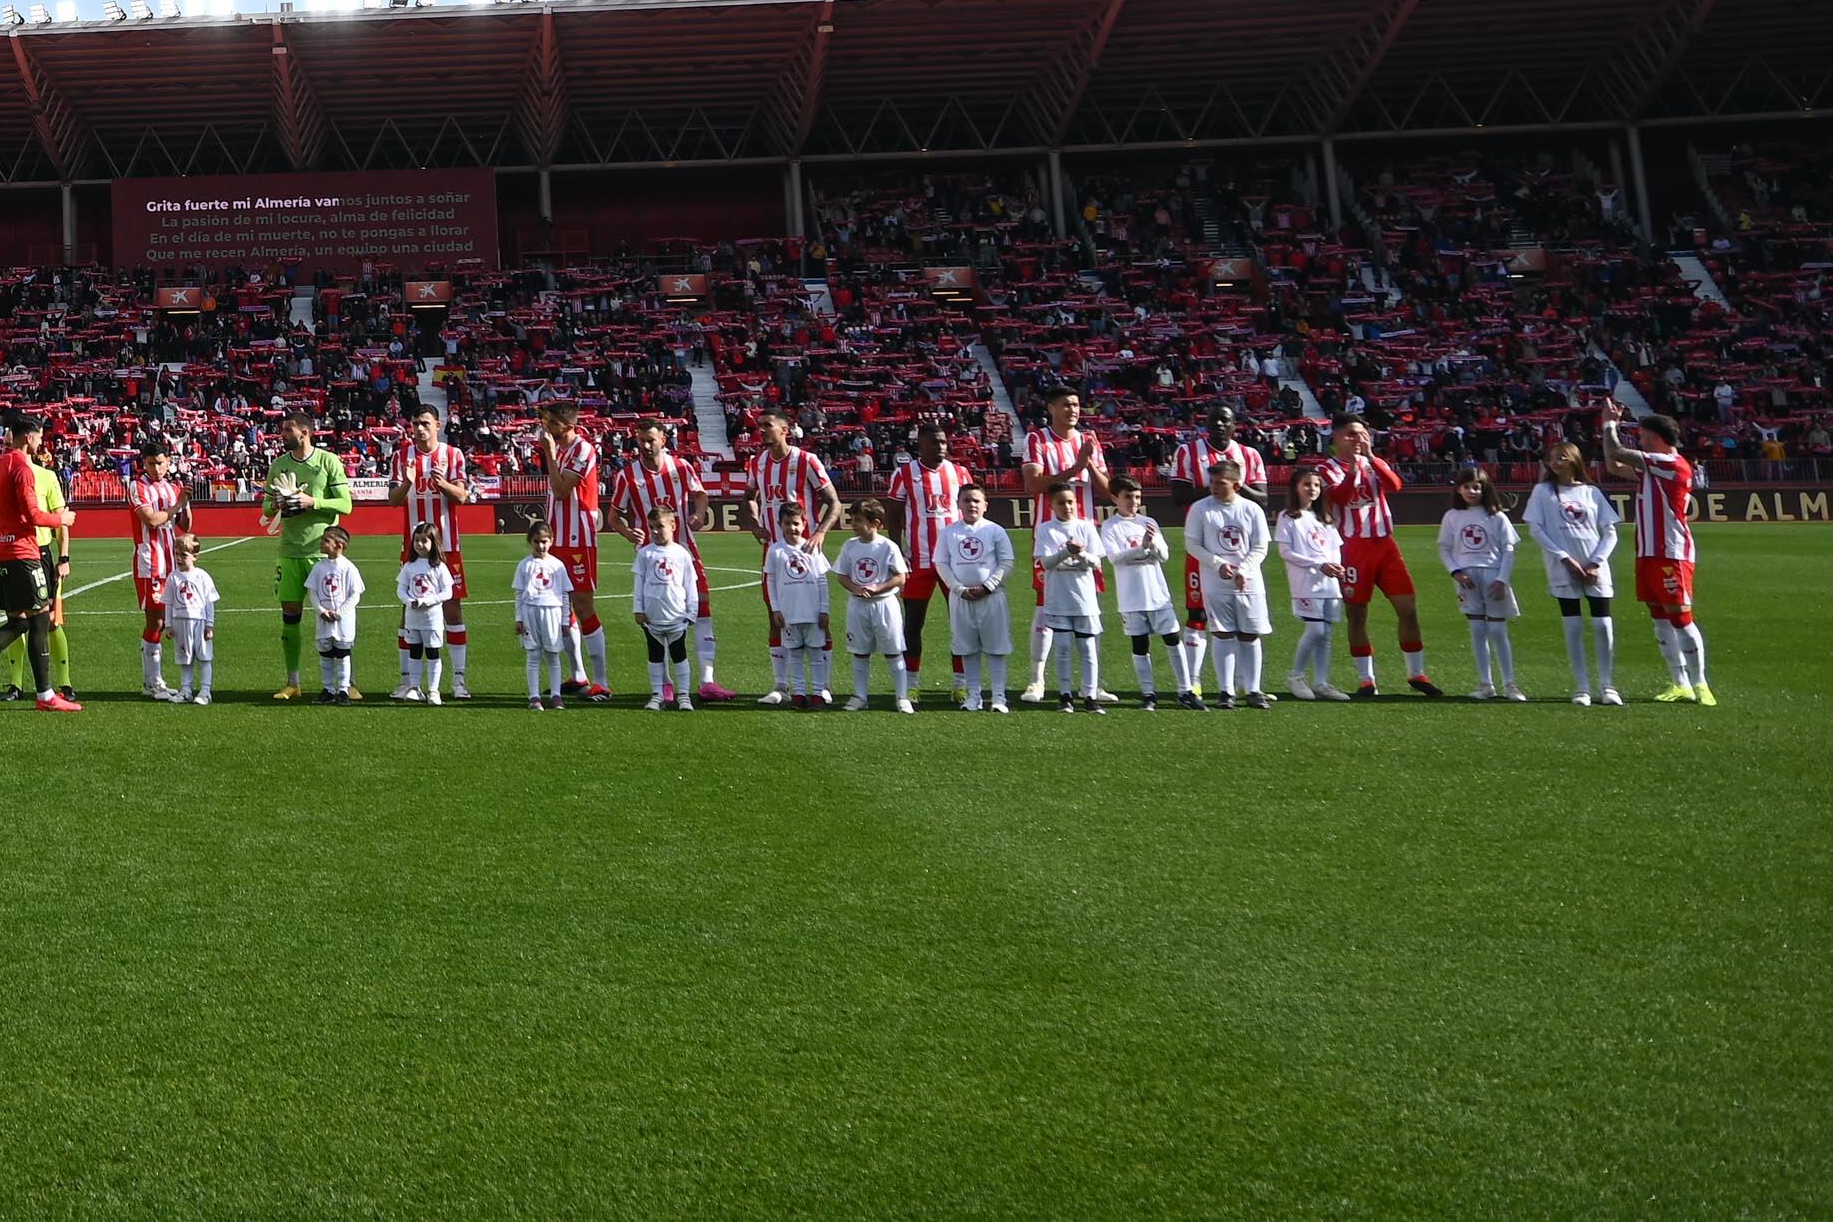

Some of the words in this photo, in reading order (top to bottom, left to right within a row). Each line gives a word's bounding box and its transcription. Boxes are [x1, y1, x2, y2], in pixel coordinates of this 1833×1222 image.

[147, 200, 181, 212] Grita
[185, 199, 229, 211] fuerte
[233, 197, 250, 210] mi
[255, 196, 311, 209] Almería
[366, 194, 412, 208] juntos
[417, 195, 425, 204] a
[429, 192, 470, 204] soñar
[162, 216, 179, 228] La
[182, 215, 229, 229] pasión
[234, 214, 251, 225] de
[255, 213, 273, 225] mi
[278, 213, 326, 225] locura,
[331, 211, 366, 223] alma
[369, 210, 388, 221] de
[392, 208, 455, 221] felicidad
[150, 233, 167, 244] En
[171, 231, 184, 243] el
[188, 231, 210, 243] día
[214, 230, 232, 242] de
[236, 230, 254, 241] mi
[258, 230, 315, 241] muerte,
[319, 229, 337, 239] no
[341, 228, 355, 238] te
[360, 228, 414, 240] pongas
[418, 227, 426, 236] a
[431, 225, 469, 236] llorar
[146, 249, 175, 262] Que
[179, 249, 205, 259] me
[206, 248, 246, 259] recen
[250, 245, 311, 258] Almería,
[315, 245, 332, 256] un
[337, 243, 387, 257] equipo
[392, 243, 418, 254] una
[423, 241, 474, 253] ciudad
[32, 567, 47, 587] 15
[152, 578, 161, 591] 5
[1189, 571, 1200, 589] 6
